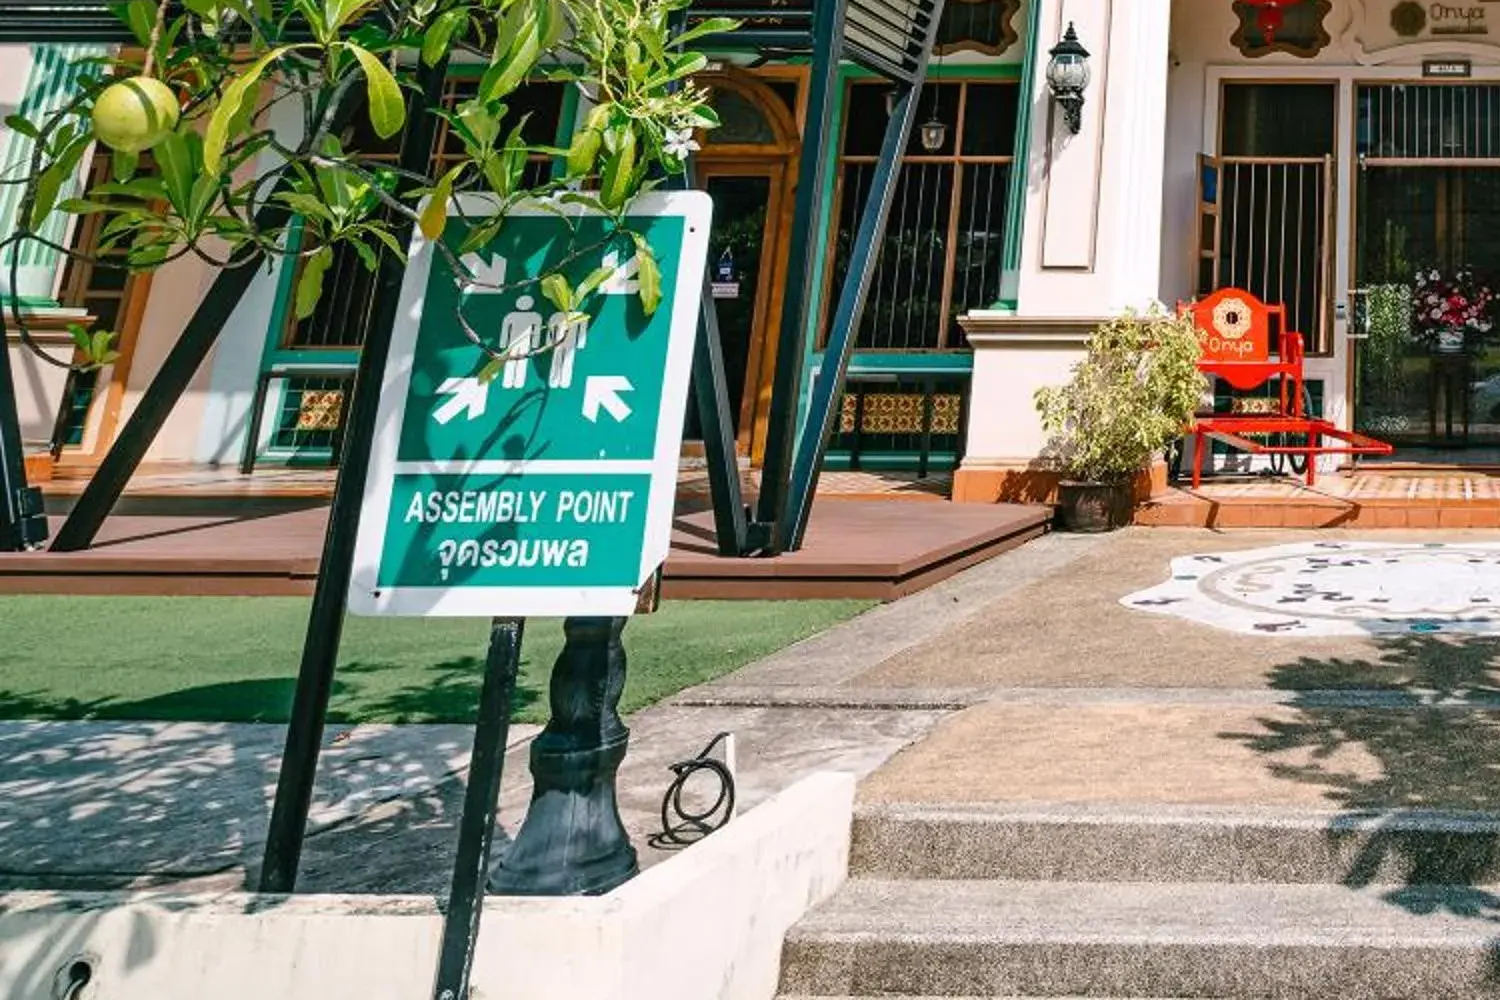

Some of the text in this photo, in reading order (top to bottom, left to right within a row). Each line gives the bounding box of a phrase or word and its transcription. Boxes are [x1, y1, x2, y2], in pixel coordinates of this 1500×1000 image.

[1429, 2, 1486, 28] Onya
[1210, 337, 1253, 358] Onya
[404, 490, 634, 523] ASSEMBLY POINT
[438, 539, 589, 581] จุดรวมพล
